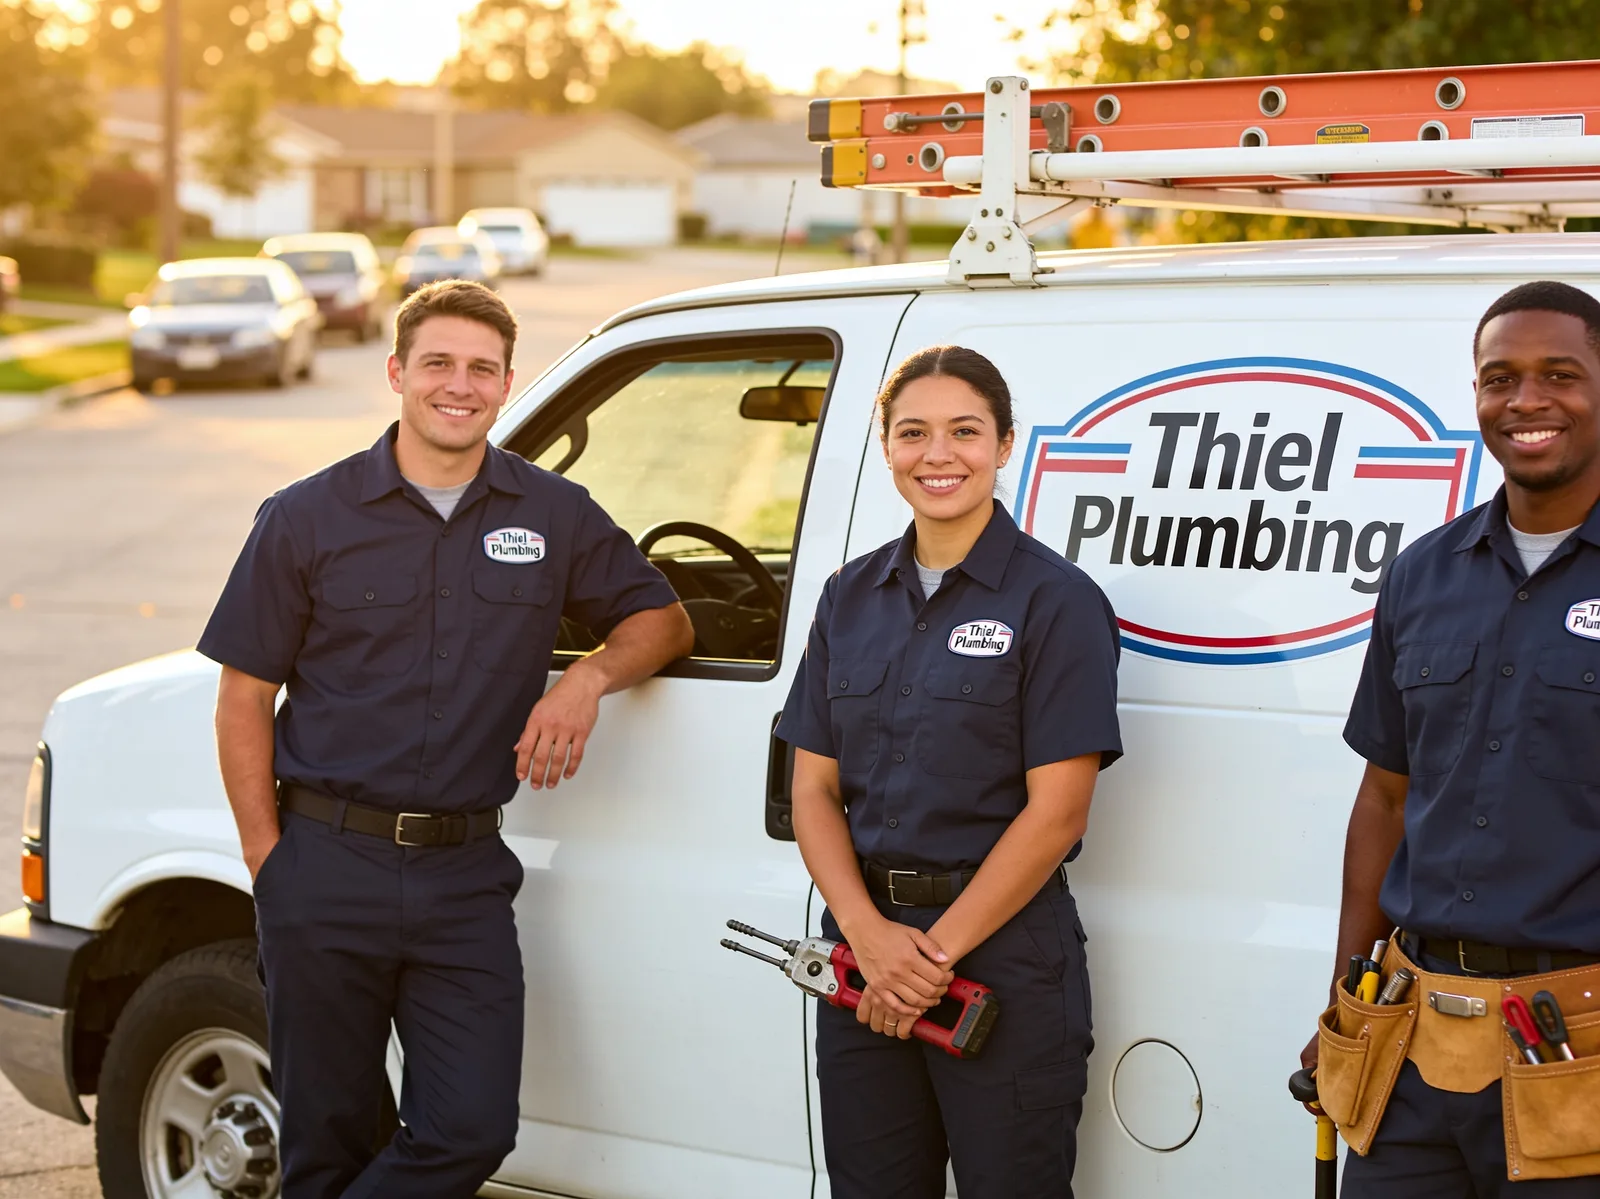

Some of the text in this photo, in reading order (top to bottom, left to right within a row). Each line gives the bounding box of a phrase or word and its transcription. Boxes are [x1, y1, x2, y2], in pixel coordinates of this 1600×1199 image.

[1149, 412, 1343, 491] Thiel
[500, 532, 527, 543] Thiel
[1065, 495, 1403, 594] Plumbing
[492, 544, 540, 558] Plumbing
[970, 625, 996, 637] Thiel
[955, 636, 1004, 653] Plumbing
